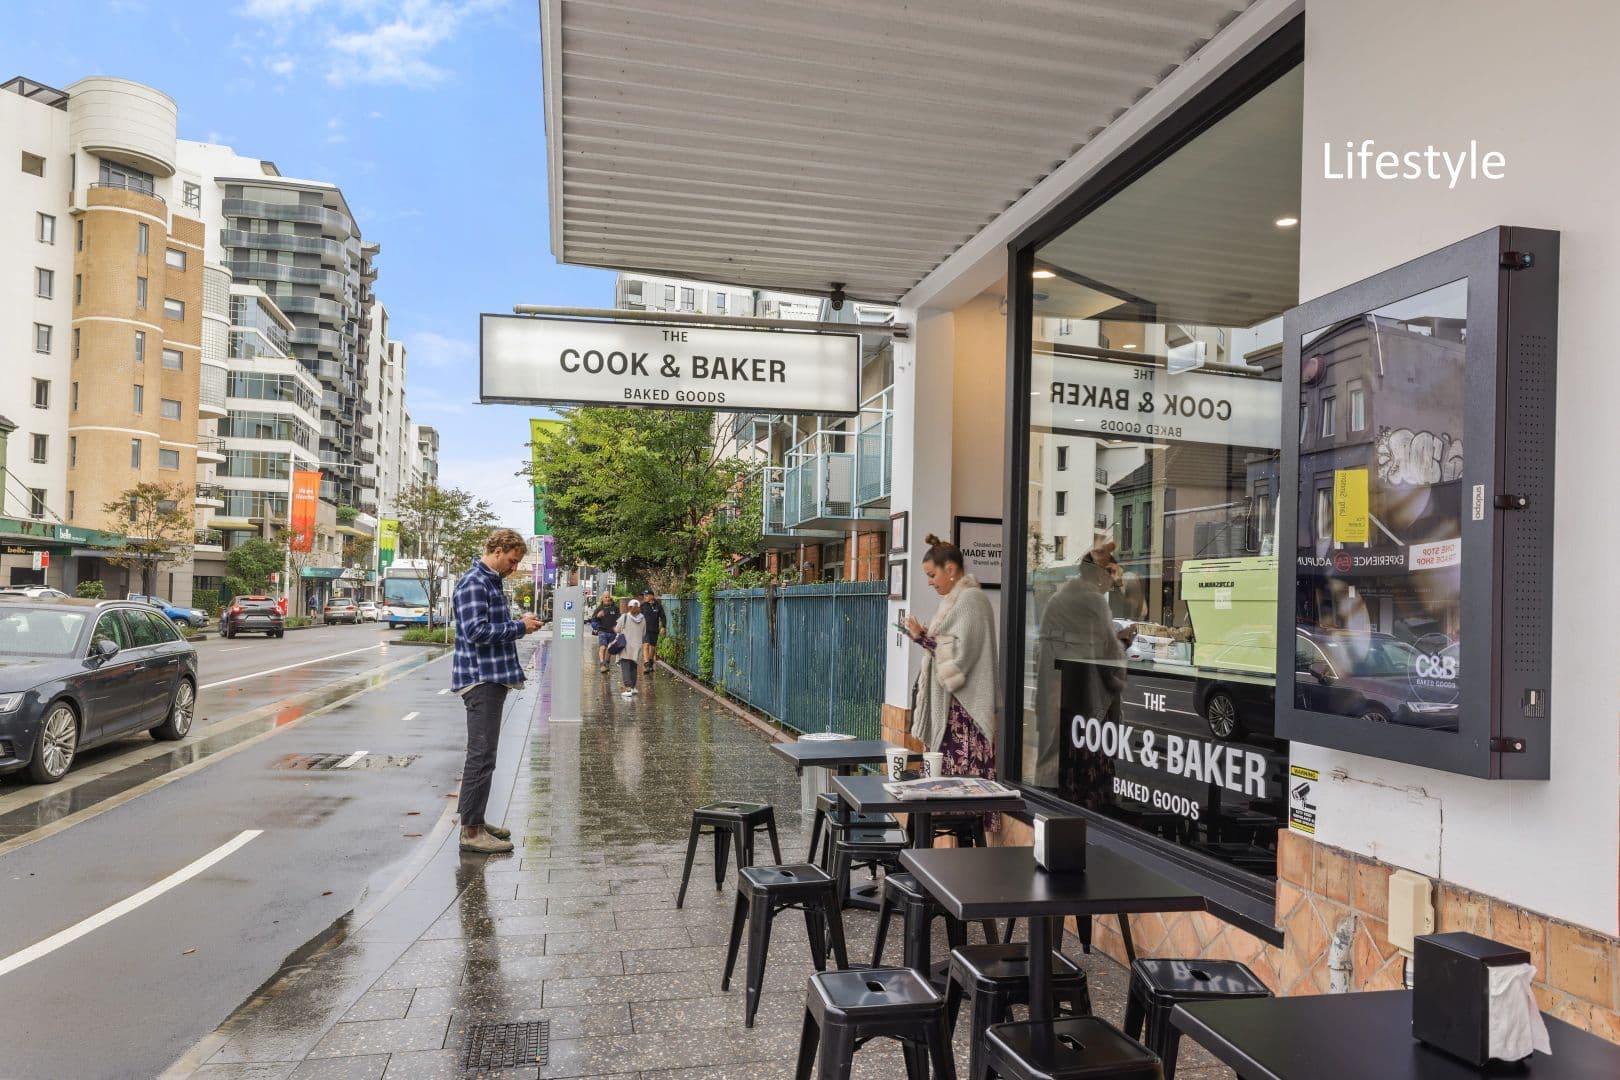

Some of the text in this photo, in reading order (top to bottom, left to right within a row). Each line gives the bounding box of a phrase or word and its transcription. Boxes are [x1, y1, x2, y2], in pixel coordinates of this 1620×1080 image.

[662, 330, 688, 343] THE
[560, 348, 786, 383] COOK & BAKER
[624, 387, 726, 404] BAKED GOODS
[962, 548, 987, 558] MADE
[1415, 654, 1456, 680] C&B
[1144, 692, 1166, 713] THE
[1071, 714, 1267, 799] COOK & BAKER
[1112, 777, 1200, 821] BAKED GOODS
